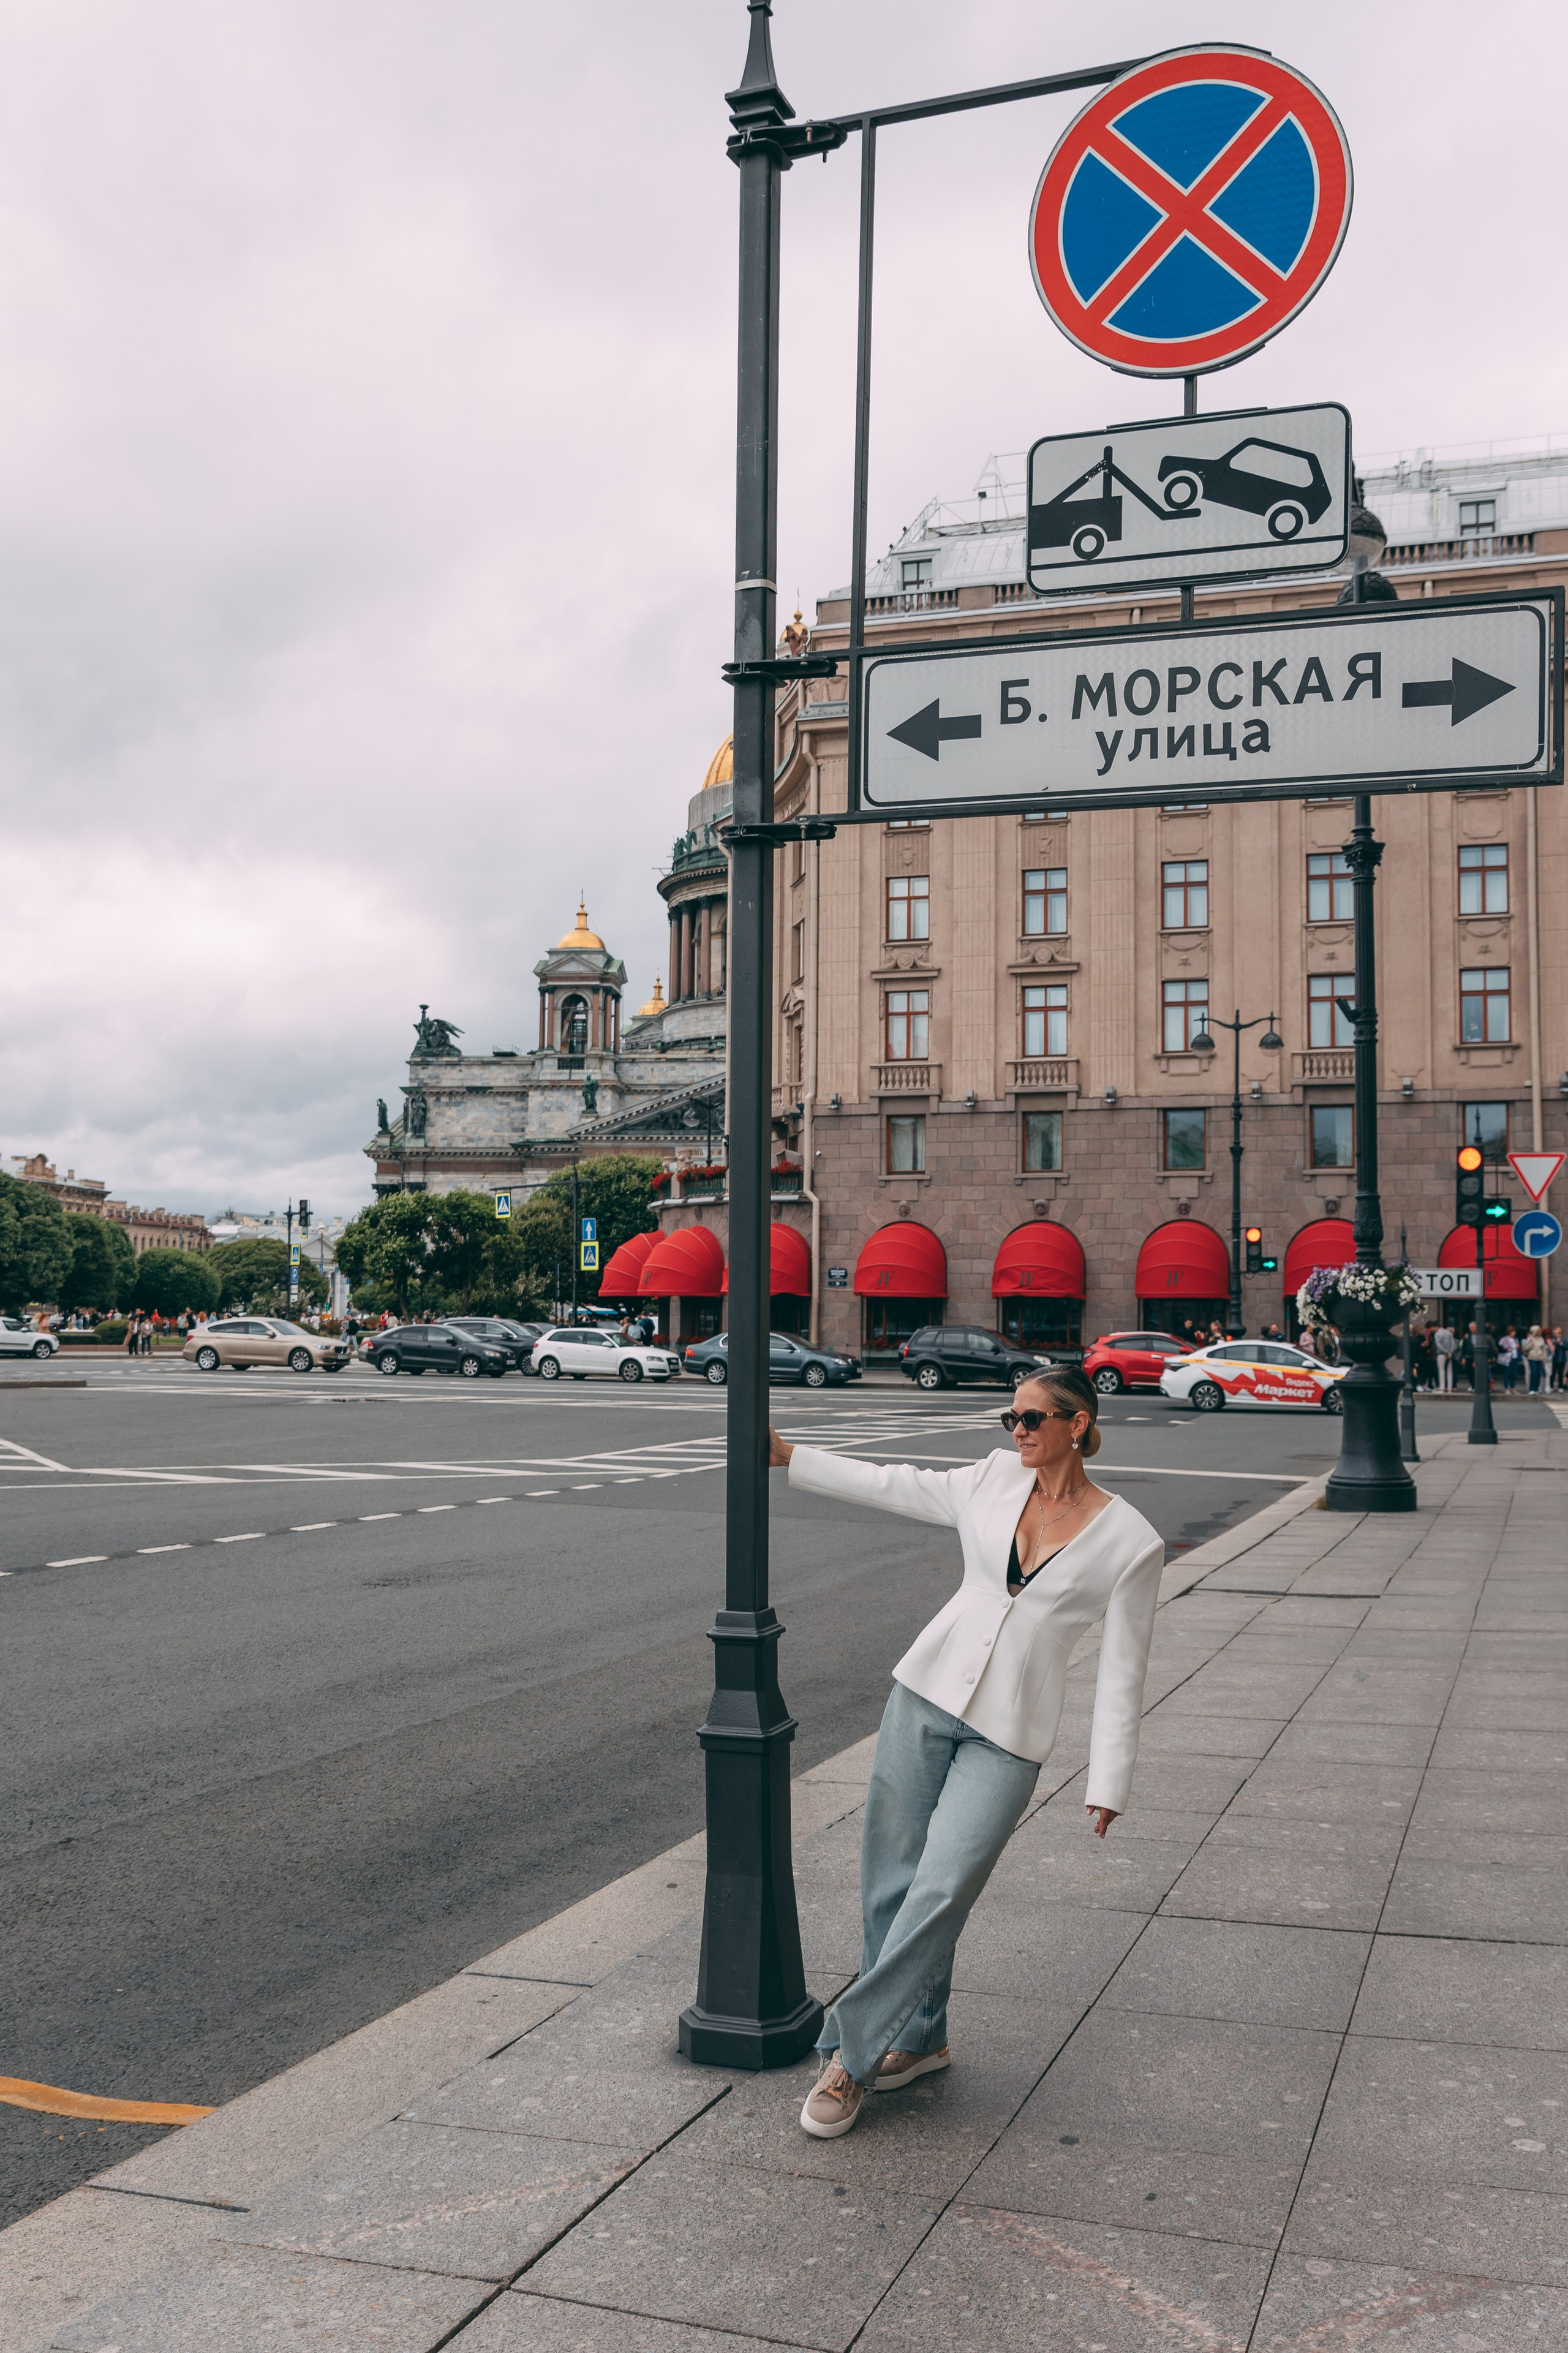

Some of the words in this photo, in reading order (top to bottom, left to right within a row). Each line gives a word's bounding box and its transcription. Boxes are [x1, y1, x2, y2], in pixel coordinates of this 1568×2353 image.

[1000, 678, 1048, 725] Б.
[1071, 651, 1382, 720] МОРСКАЯ
[1095, 719, 1272, 777] улица
[1418, 1273, 1469, 1291] ТОП
[1254, 1383, 1315, 1398] Маркет
[1285, 1377, 1315, 1388] Яндекс
